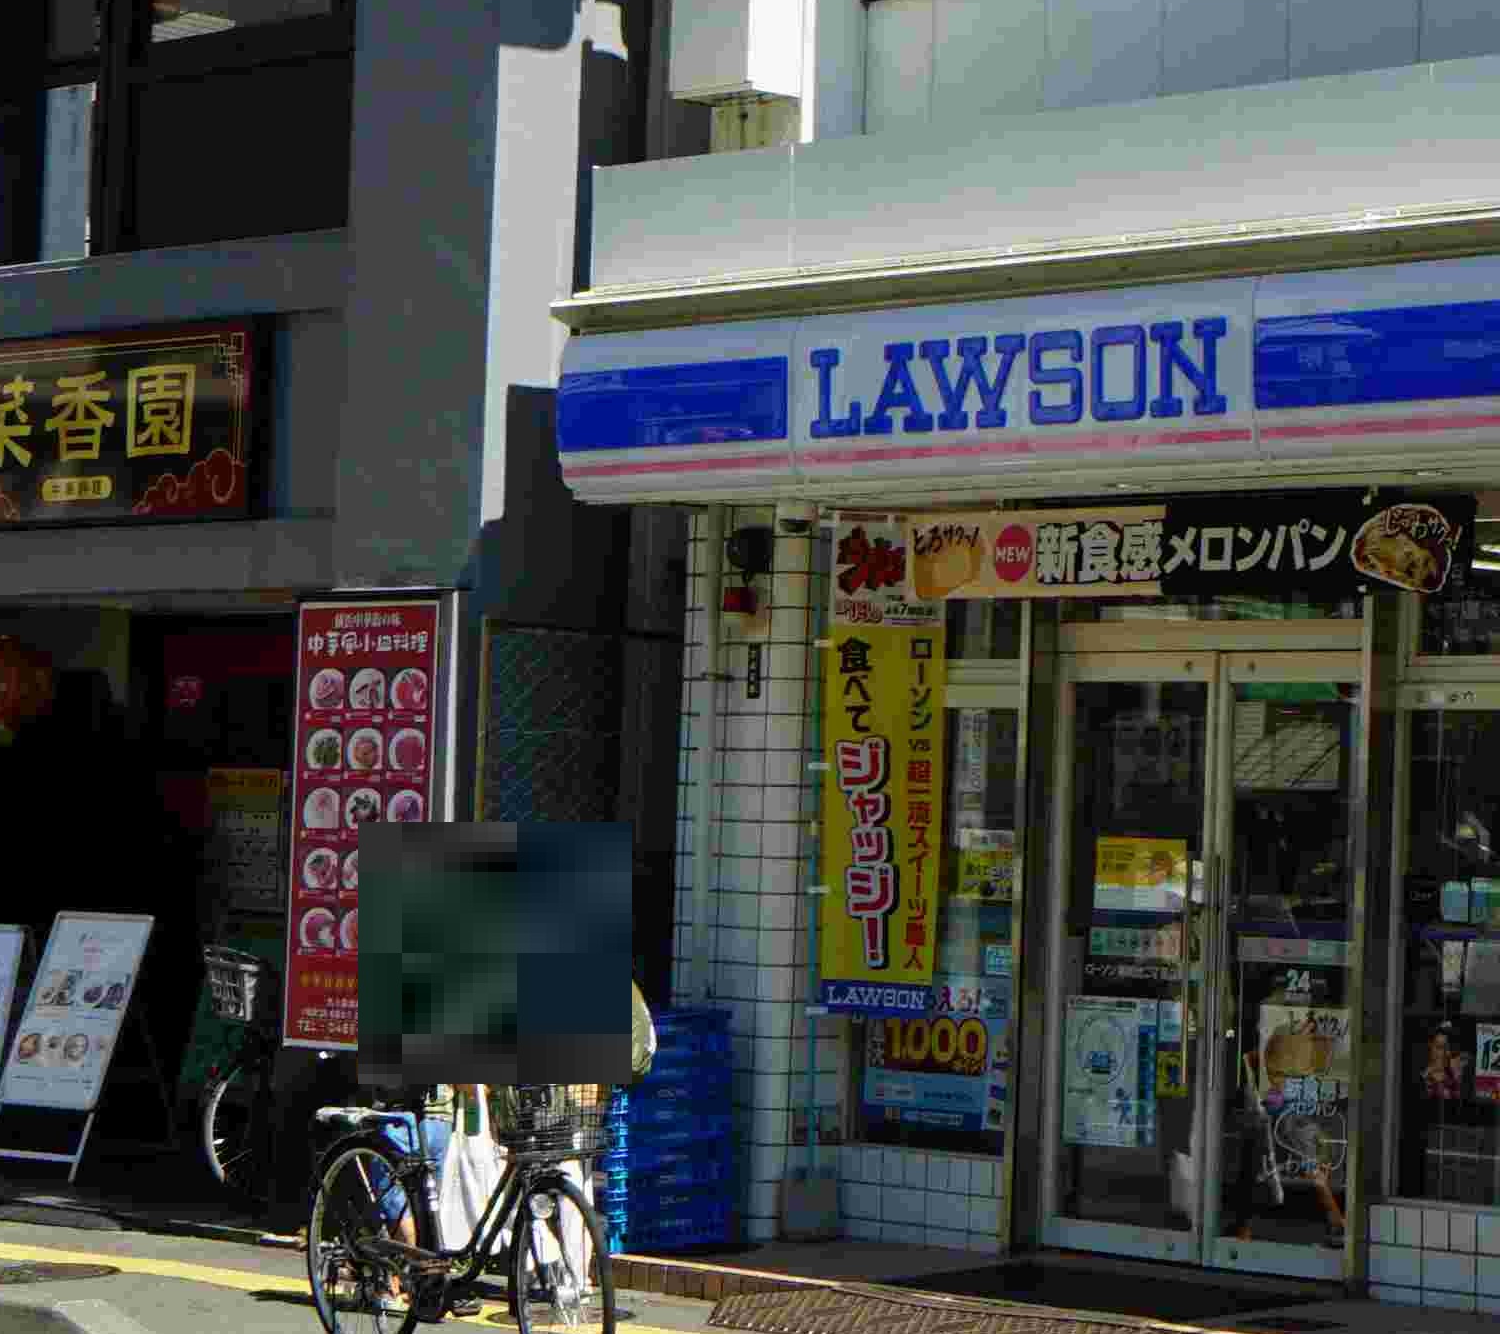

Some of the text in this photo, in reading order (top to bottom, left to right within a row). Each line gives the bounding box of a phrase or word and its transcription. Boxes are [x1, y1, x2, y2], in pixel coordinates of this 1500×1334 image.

[810, 316, 1228, 439] LAWSON
[995, 547, 1032, 564] NEW
[1036, 521, 1346, 585] 新食感メロンパン
[836, 635, 873, 733] 食べて
[908, 637, 934, 731] ローソン
[834, 737, 900, 970] ジャッジ!
[827, 985, 927, 1011] LAWSON
